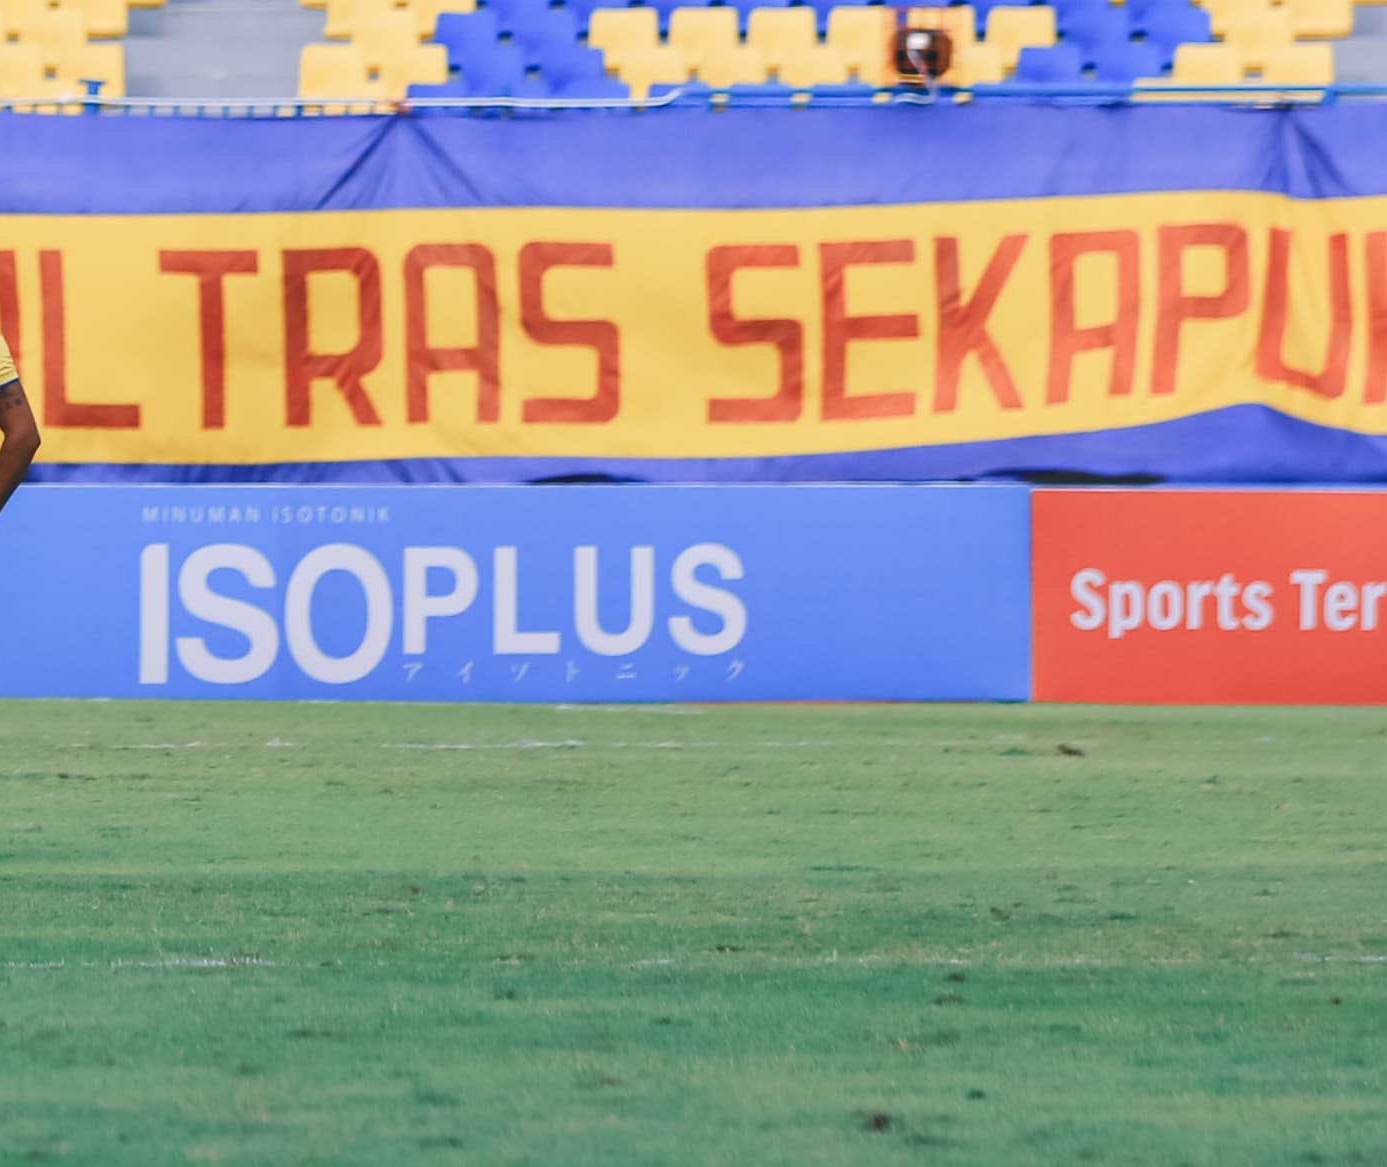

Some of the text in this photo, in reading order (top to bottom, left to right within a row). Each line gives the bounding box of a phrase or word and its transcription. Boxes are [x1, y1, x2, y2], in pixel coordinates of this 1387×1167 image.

[705, 221, 1387, 424] SEKAPU
[141, 506, 391, 524] MINUMAN ISOTONIK
[138, 542, 748, 685] ISOPLUS
[1070, 568, 1274, 639] Sports
